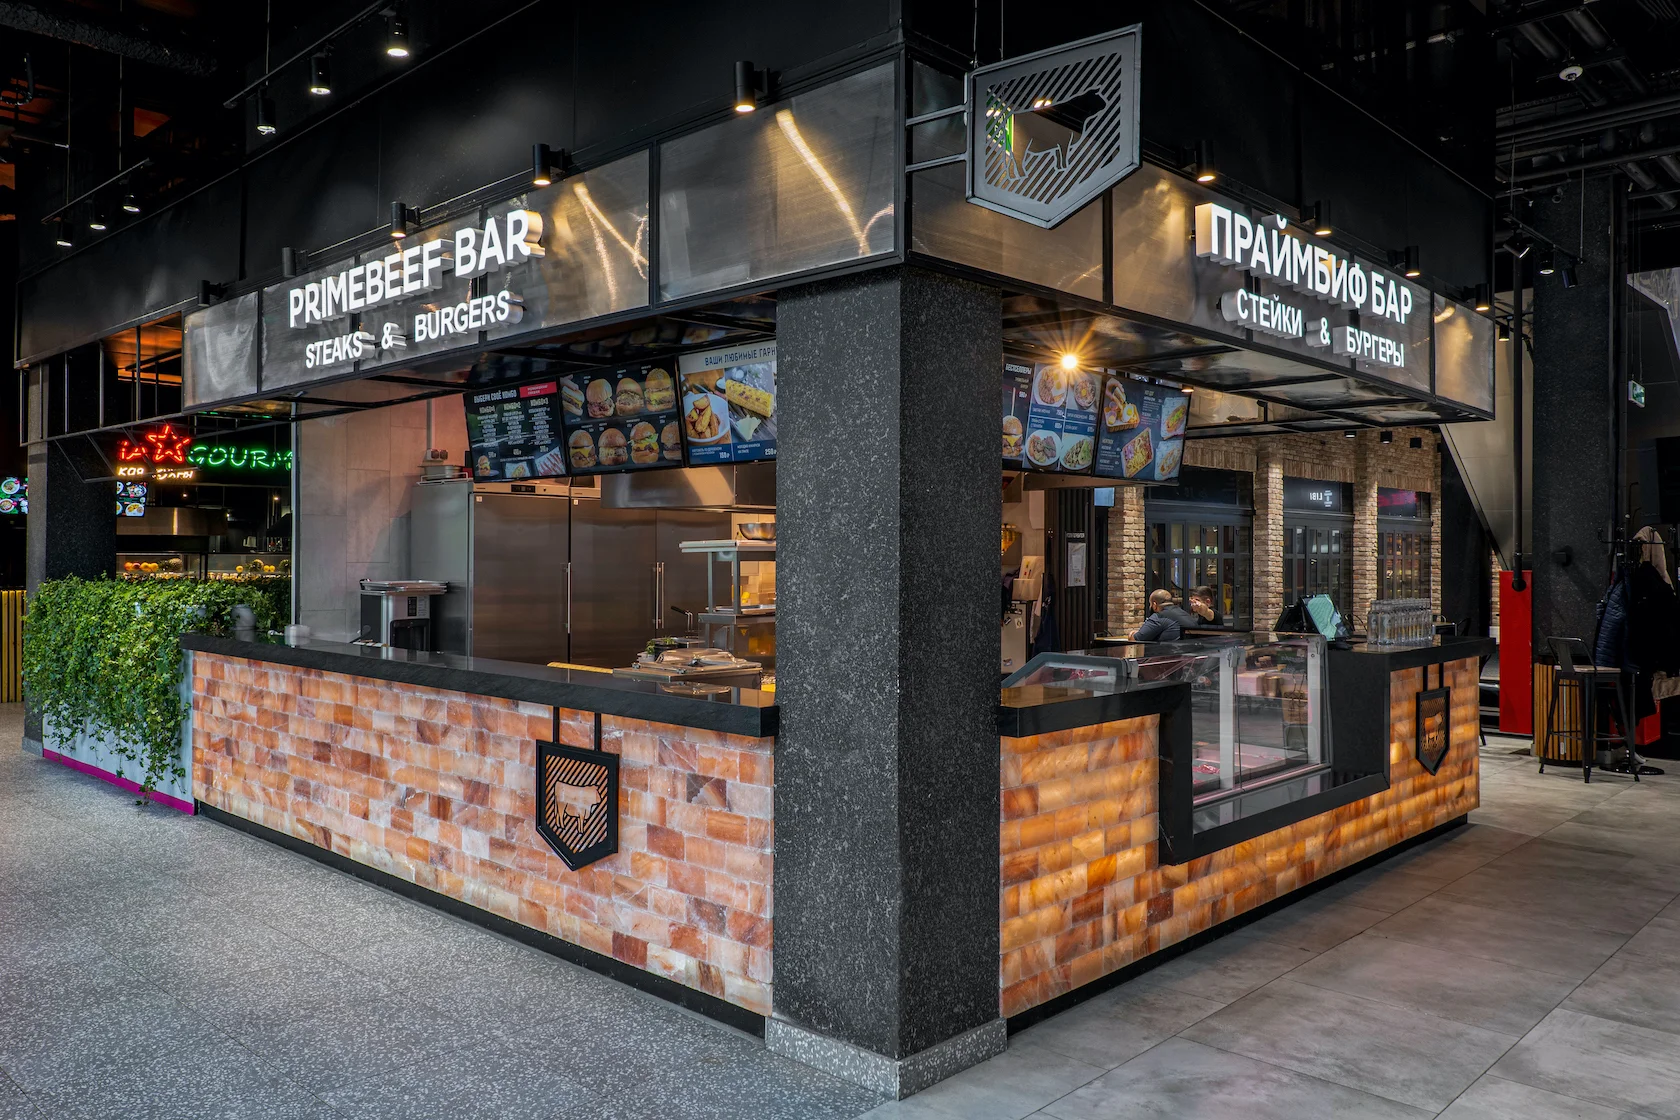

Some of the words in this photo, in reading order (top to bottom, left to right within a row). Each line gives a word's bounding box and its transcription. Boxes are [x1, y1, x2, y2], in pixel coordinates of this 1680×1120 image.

[289, 238, 443, 328] PRIMEBEEF
[455, 208, 532, 278] BAR
[1211, 202, 1367, 309] ПРАЙМБИФ
[1371, 271, 1413, 324] БАР
[305, 331, 364, 369] STEAKS
[381, 322, 397, 350] &
[414, 290, 511, 343] BURGERS
[704, 355, 723, 366] ВАШИ
[724, 349, 758, 363] ЛЮБИМЫЕ
[1236, 288, 1303, 338] СТЕЙКИ
[1320, 316, 1332, 346] &
[1346, 326, 1405, 368] БУРГЕРЫ
